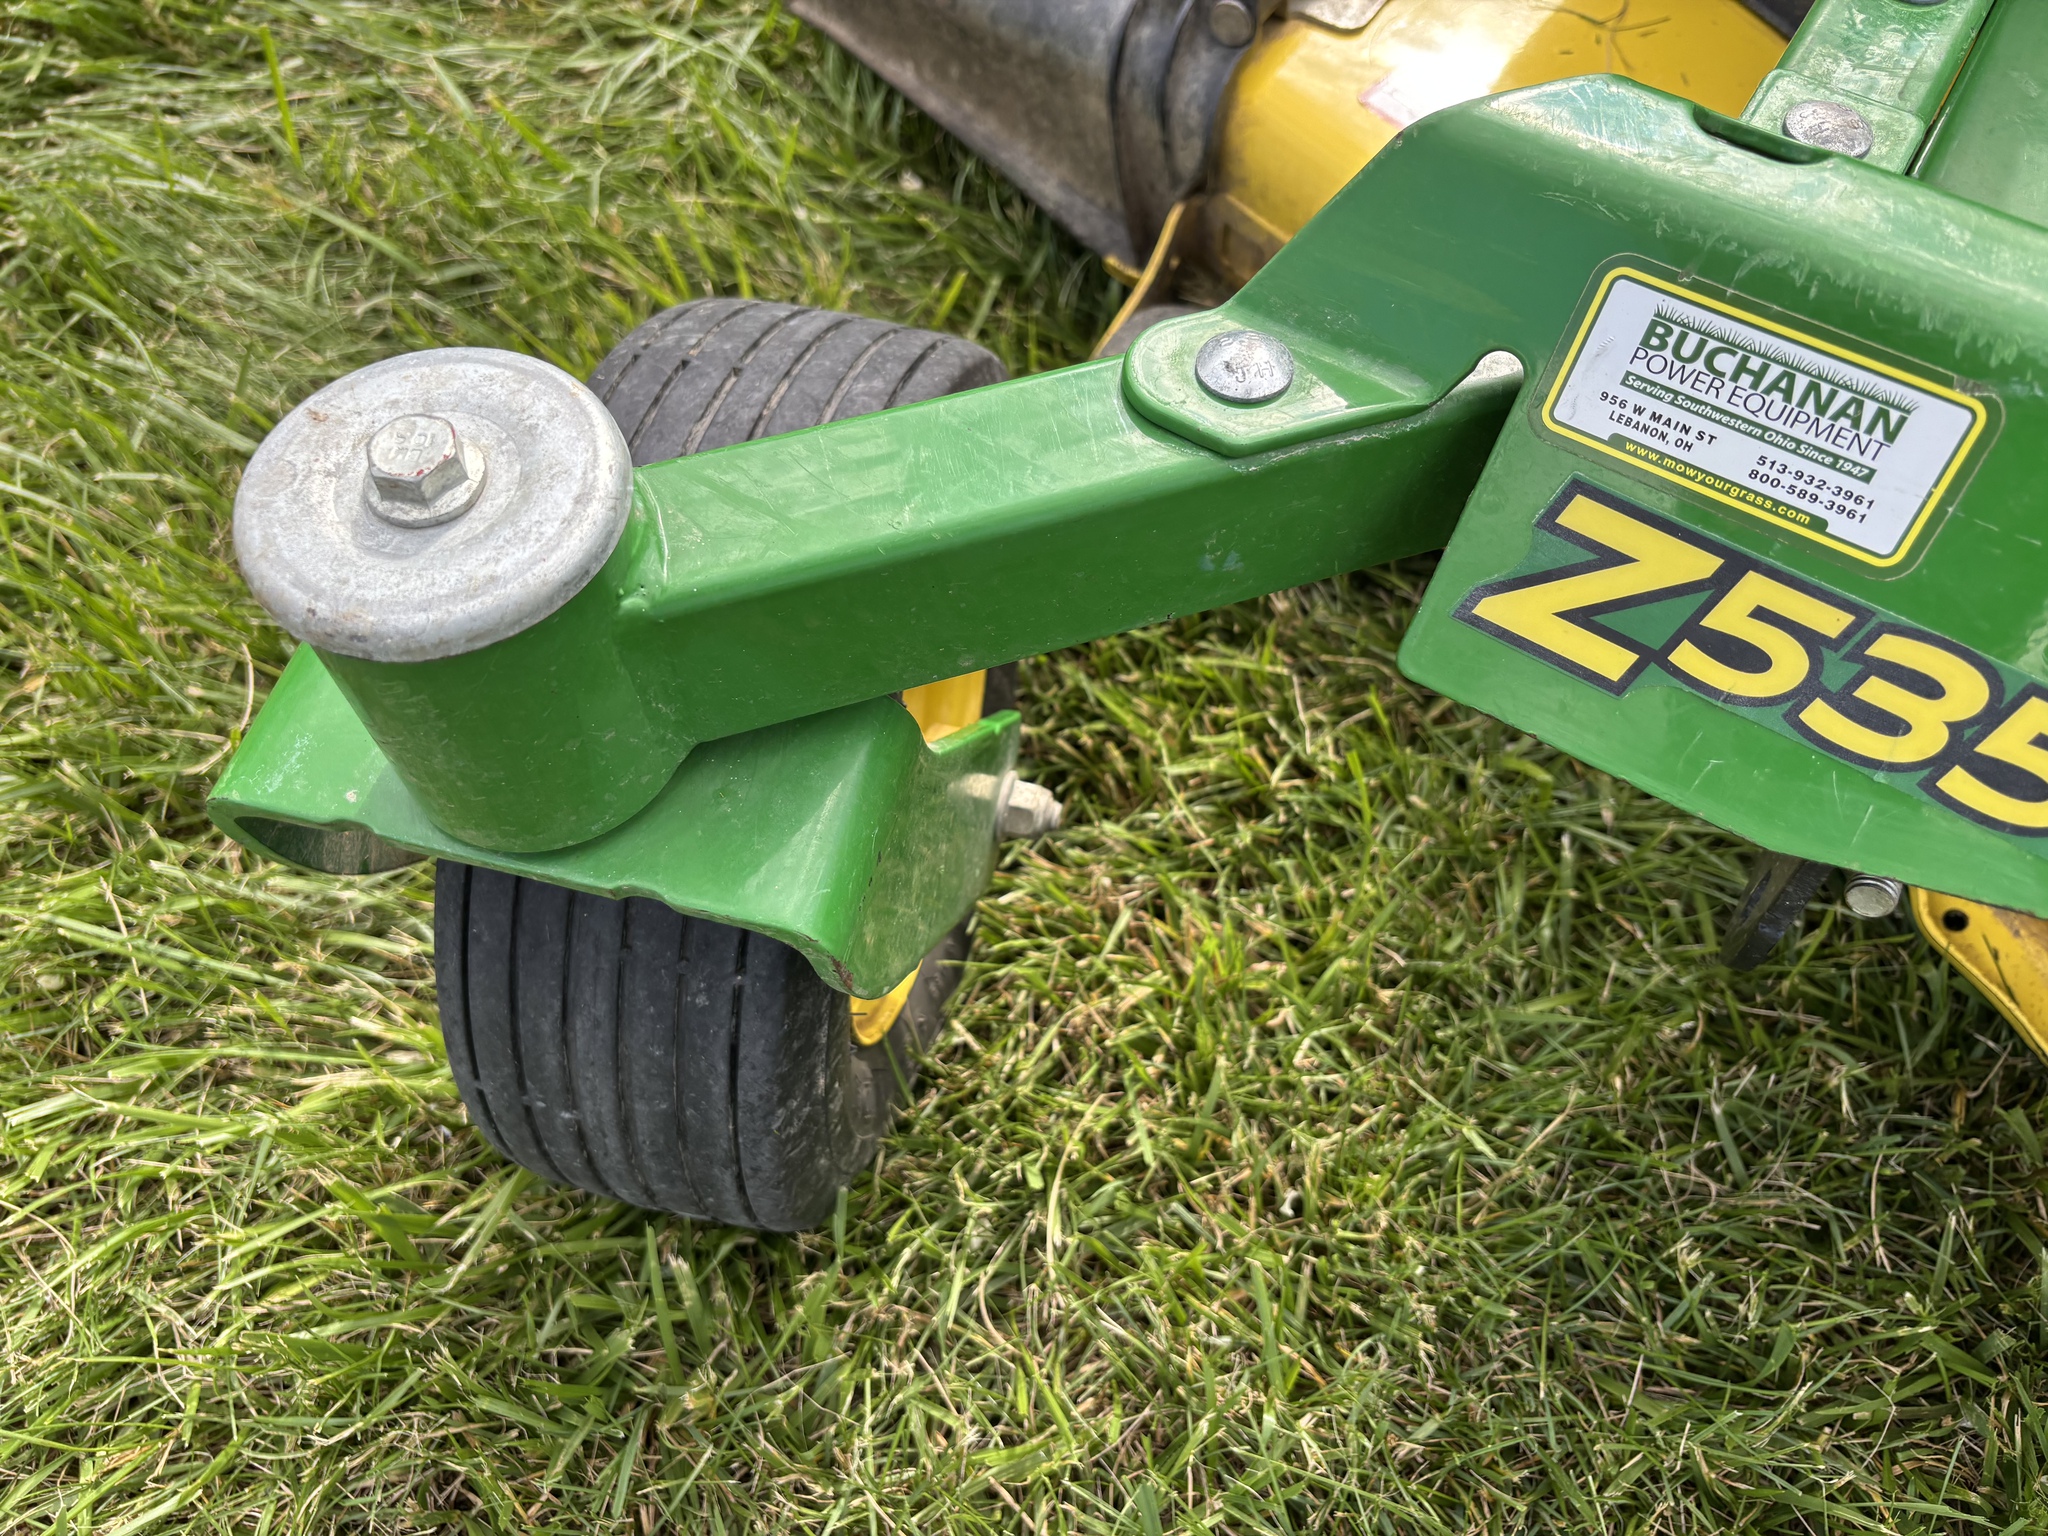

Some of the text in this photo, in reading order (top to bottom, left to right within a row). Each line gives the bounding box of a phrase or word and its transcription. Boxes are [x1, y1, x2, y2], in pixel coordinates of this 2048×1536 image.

[1599, 391, 1718, 446] 956 W MAIN ST
[1629, 346, 1891, 462] POWER EQUIPMENT
[1639, 318, 1908, 445] BUCHANAN
[1608, 410, 1695, 453] LEBANON, OH
[1625, 374, 1870, 479] Serving Southwestern Ohio Since 1947
[1624, 441, 1811, 525] www.mowyourgrass.com
[1748, 468, 1867, 524] 800-589-3961
[1756, 455, 1875, 510] 513-932-3961
[1469, 492, 2048, 829] Z535
